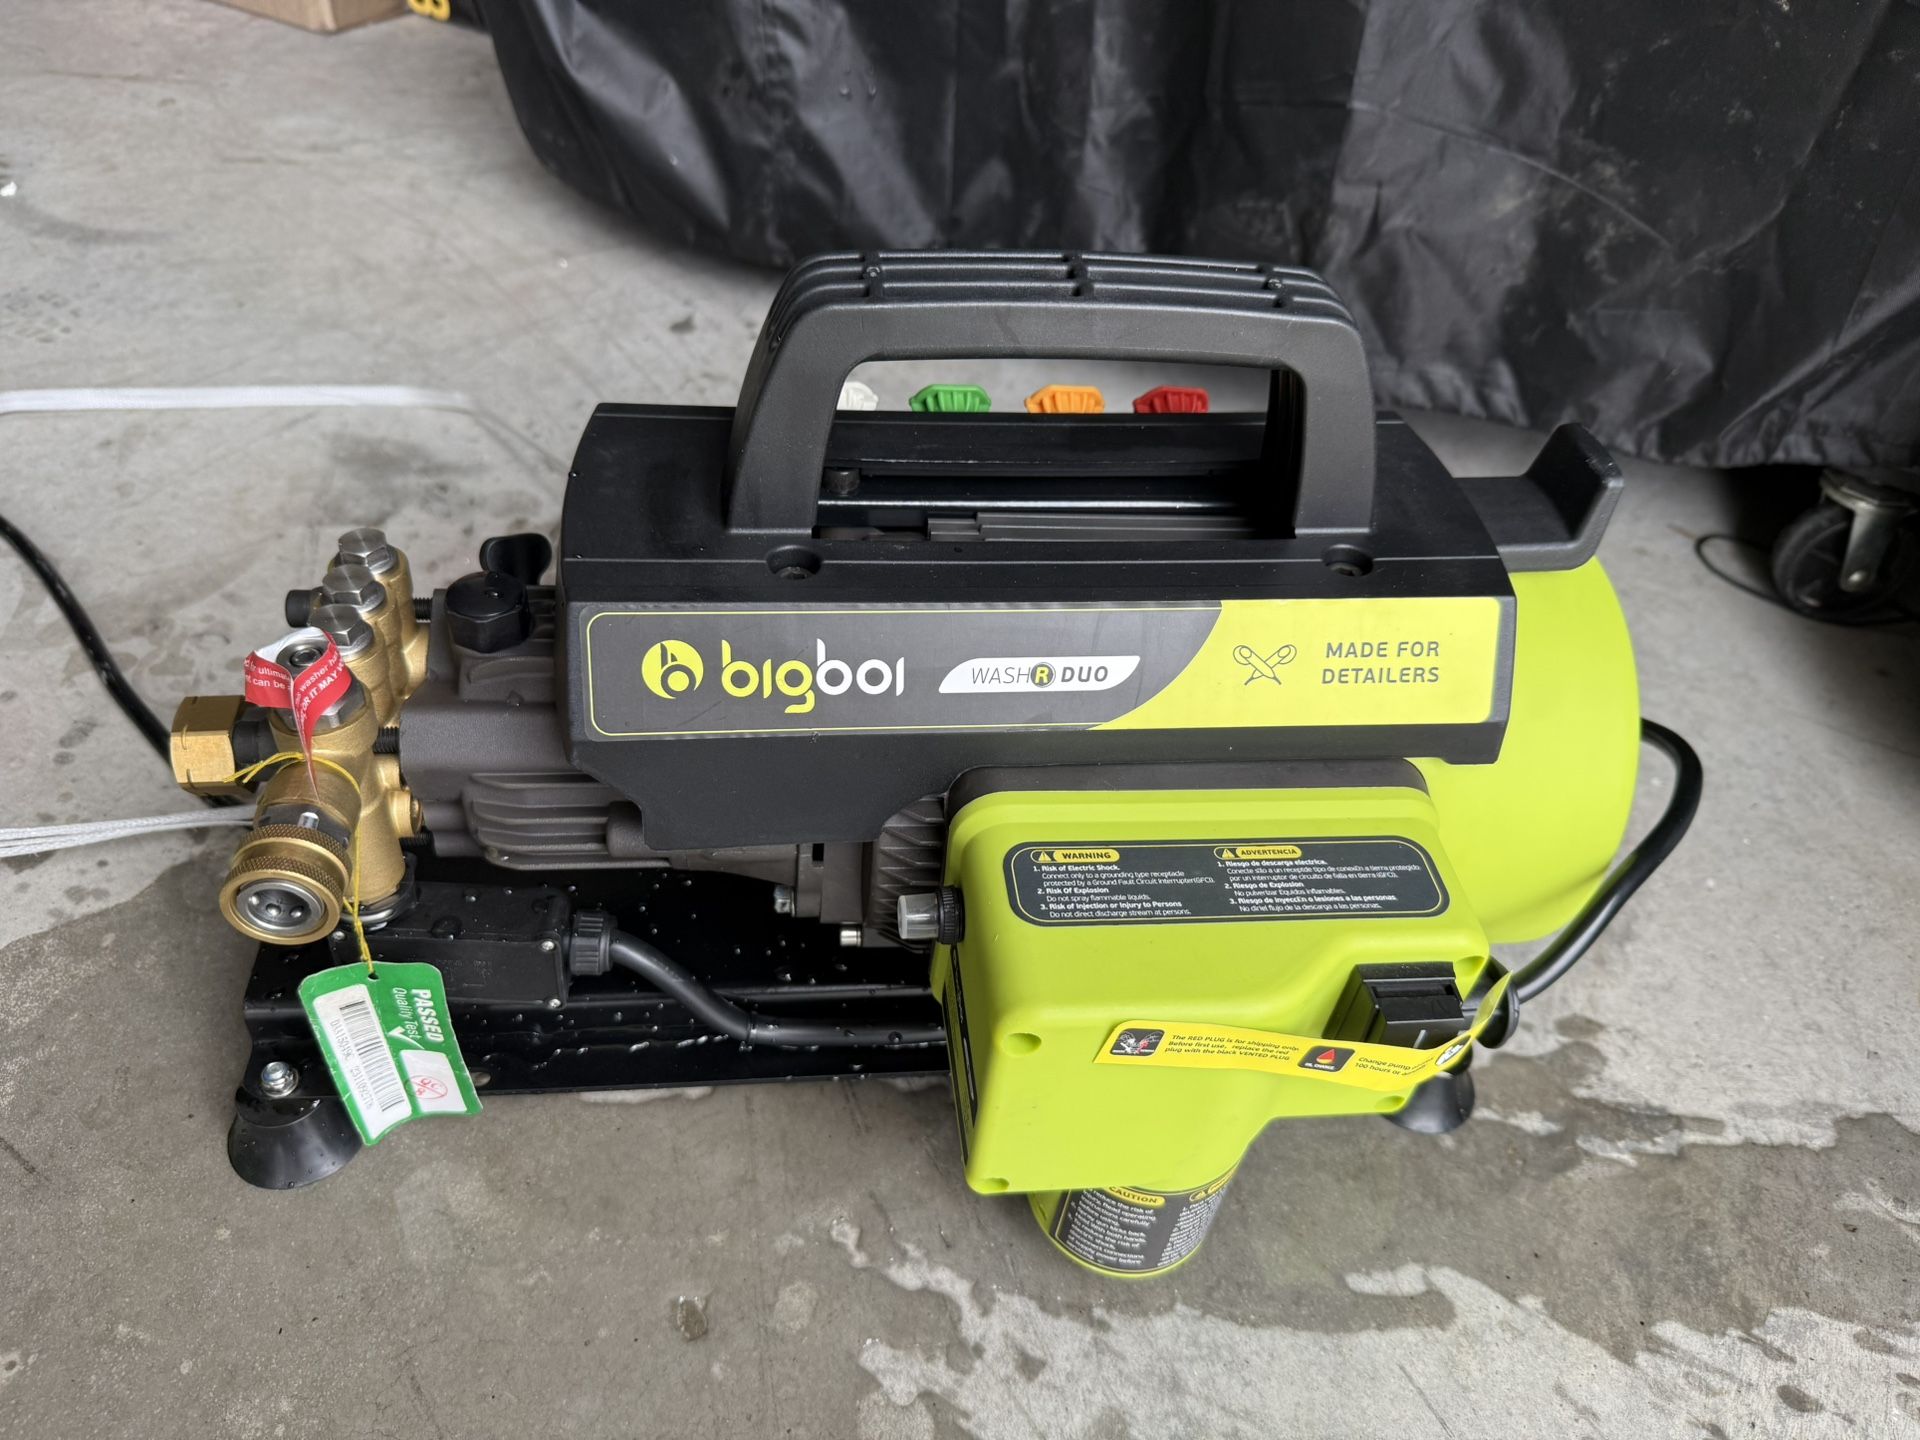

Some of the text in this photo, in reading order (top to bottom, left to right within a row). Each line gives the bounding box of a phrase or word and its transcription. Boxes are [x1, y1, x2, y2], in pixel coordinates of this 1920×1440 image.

[1326, 641, 1440, 658] MADE FOR
[721, 638, 905, 714] bigboi
[1061, 665, 1109, 683] DUO
[1321, 667, 1440, 684] DETAILERS
[253, 679, 270, 687] can
[1073, 886, 1110, 895] Explosion
[1076, 902, 1109, 910] Injection
[392, 987, 421, 1041] Quality Test
[411, 989, 445, 1043] PASSED
[1240, 1050, 1268, 1058] VENTED
[1358, 1056, 1387, 1066] Change
[1388, 1062, 1411, 1070] pump
[1369, 1065, 1391, 1073] hours
[1109, 1186, 1157, 1204] CAUTION
